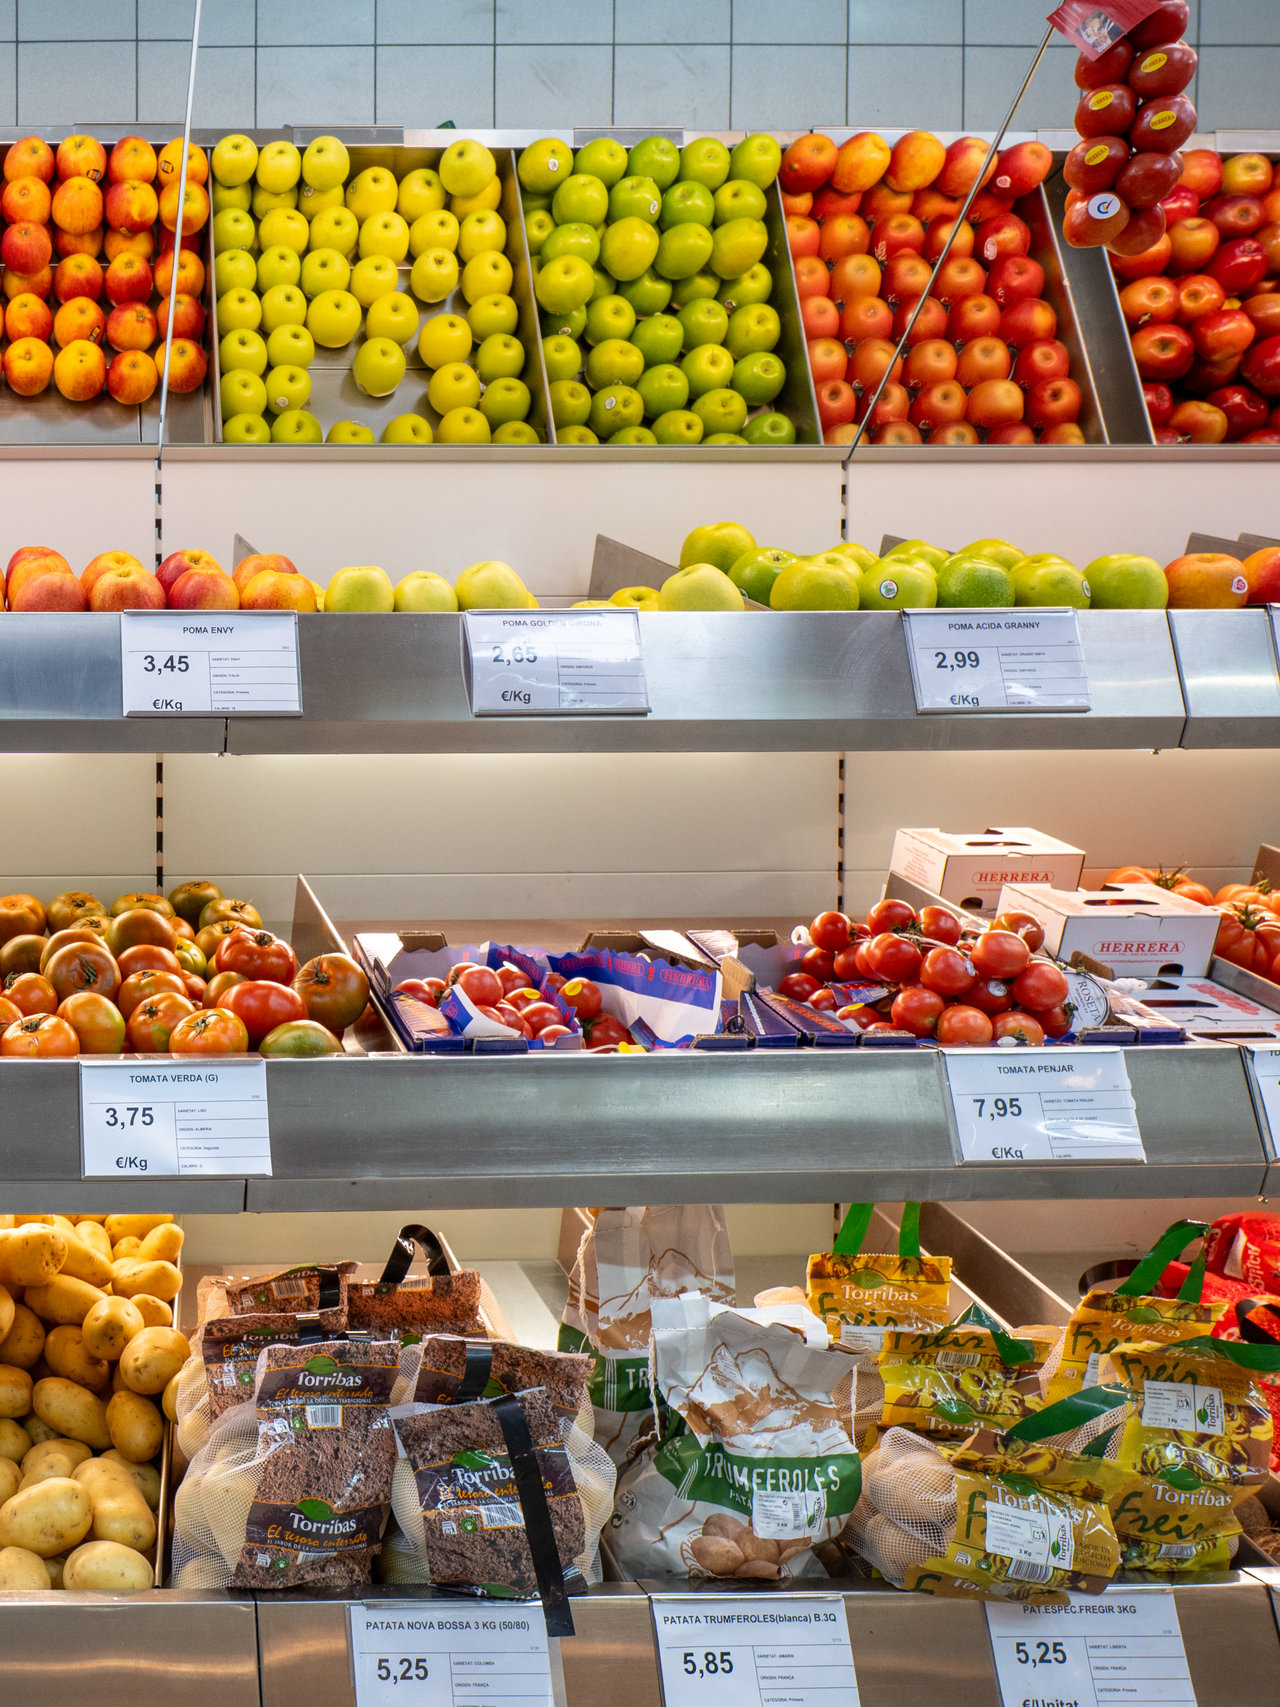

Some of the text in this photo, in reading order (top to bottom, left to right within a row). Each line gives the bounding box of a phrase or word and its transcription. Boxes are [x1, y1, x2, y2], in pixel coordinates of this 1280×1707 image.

[144, 655, 189, 675] 3,45
[492, 646, 537, 665] 2,65
[935, 651, 980, 671] 2,99
[153, 699, 182, 711] €/Kg
[501, 691, 531, 703] €/Kg
[950, 695, 979, 707] €/Kg
[978, 872, 1049, 882] HERRERA
[1099, 943, 1180, 952] HERRERA
[1078, 981, 1100, 1021] ROSETA
[130, 1075, 168, 1083] TOMATA
[205, 1074, 218, 1083] (G)
[997, 1065, 1074, 1074] TOMATA PENJAR
[106, 1107, 154, 1129] 3,75
[973, 1098, 1022, 1121] 7,95
[992, 1147, 1023, 1159] €/Kg
[116, 1157, 148, 1171] €/Kg
[841, 1284, 919, 1301] Torribas
[1112, 1317, 1183, 1338] Torribas
[297, 1371, 362, 1386] Torribas
[275, 1388, 288, 1399] El
[1207, 1393, 1216, 1428] Torribas
[451, 1464, 515, 1484] Torriba
[705, 1452, 840, 1492] TRUMFEROLES
[729, 1489, 752, 1510] PATA
[1151, 1484, 1233, 1507] Torribas
[290, 1512, 356, 1534] Torribas
[1113, 1491, 1204, 1540] Freir
[267, 1524, 282, 1538] El
[284, 1530, 320, 1546] tesoro
[1058, 1524, 1068, 1561] Torribas
[663, 1613, 837, 1625] PATATA TRUMFEROLES(blanca) B.3Q
[1023, 1605, 1136, 1614] PAT.ESPEC.FREGIR 3KG
[366, 1621, 529, 1632] PATATA NOVA BOSSA 3 KG (50/80)
[683, 1651, 733, 1678] 5,85
[1016, 1641, 1067, 1668] 5,25
[377, 1658, 428, 1684] 5,25
